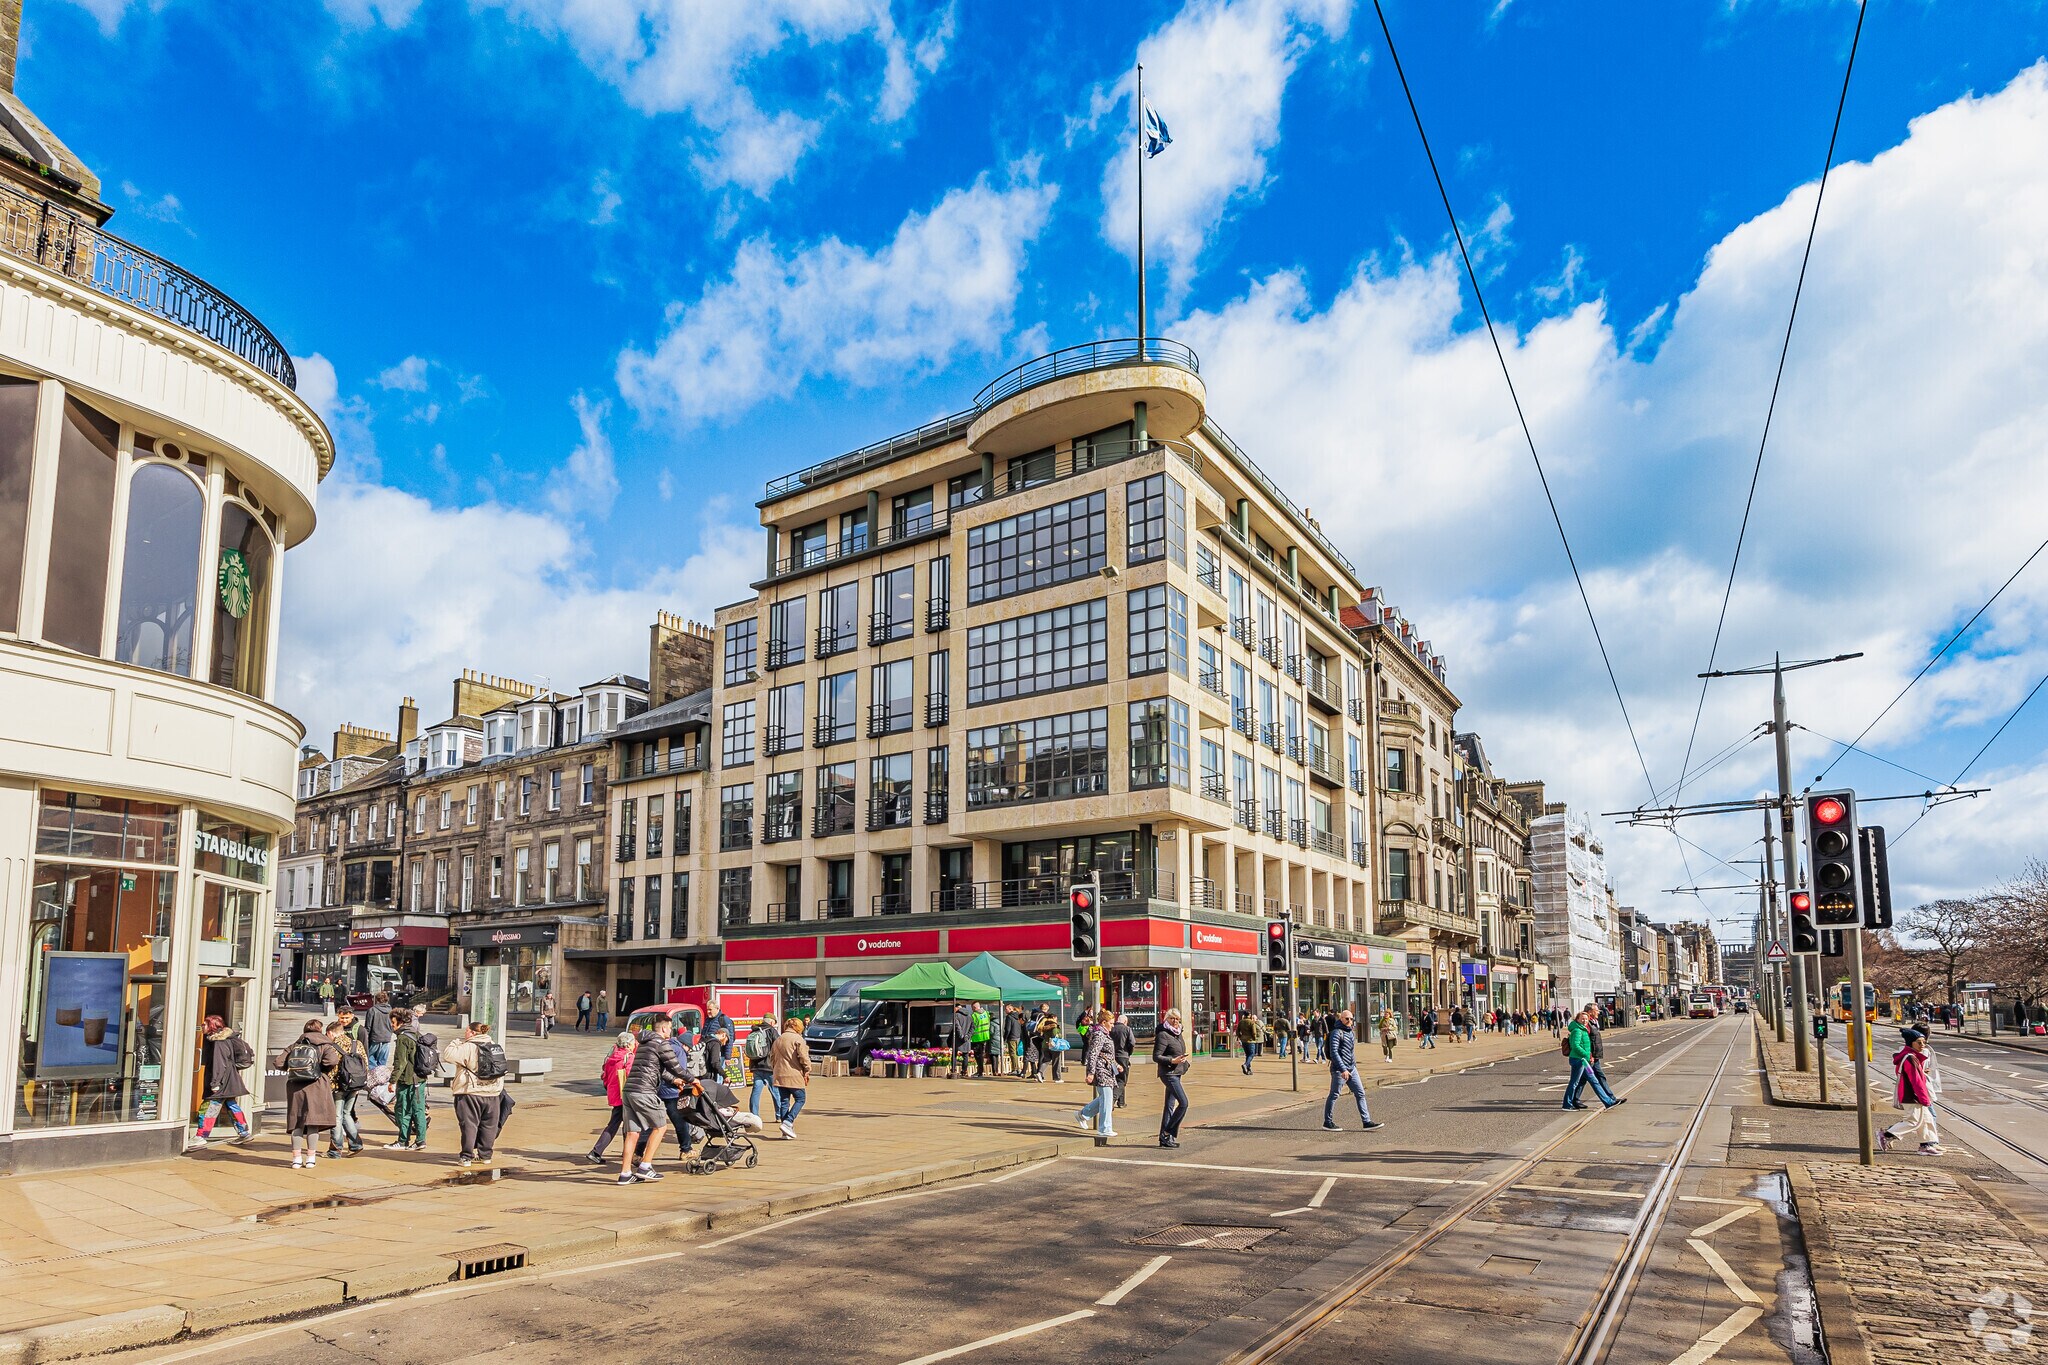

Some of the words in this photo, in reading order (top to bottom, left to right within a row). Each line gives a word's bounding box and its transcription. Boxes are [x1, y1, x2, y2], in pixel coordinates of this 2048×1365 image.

[194, 830, 268, 867] STARBUCKS
[359, 932, 374, 940] COSTA
[1202, 934, 1223, 944] vodafone
[868, 939, 901, 949] vodafone
[1315, 945, 1329, 957] LUSH
[1091, 967, 1101, 980] H
